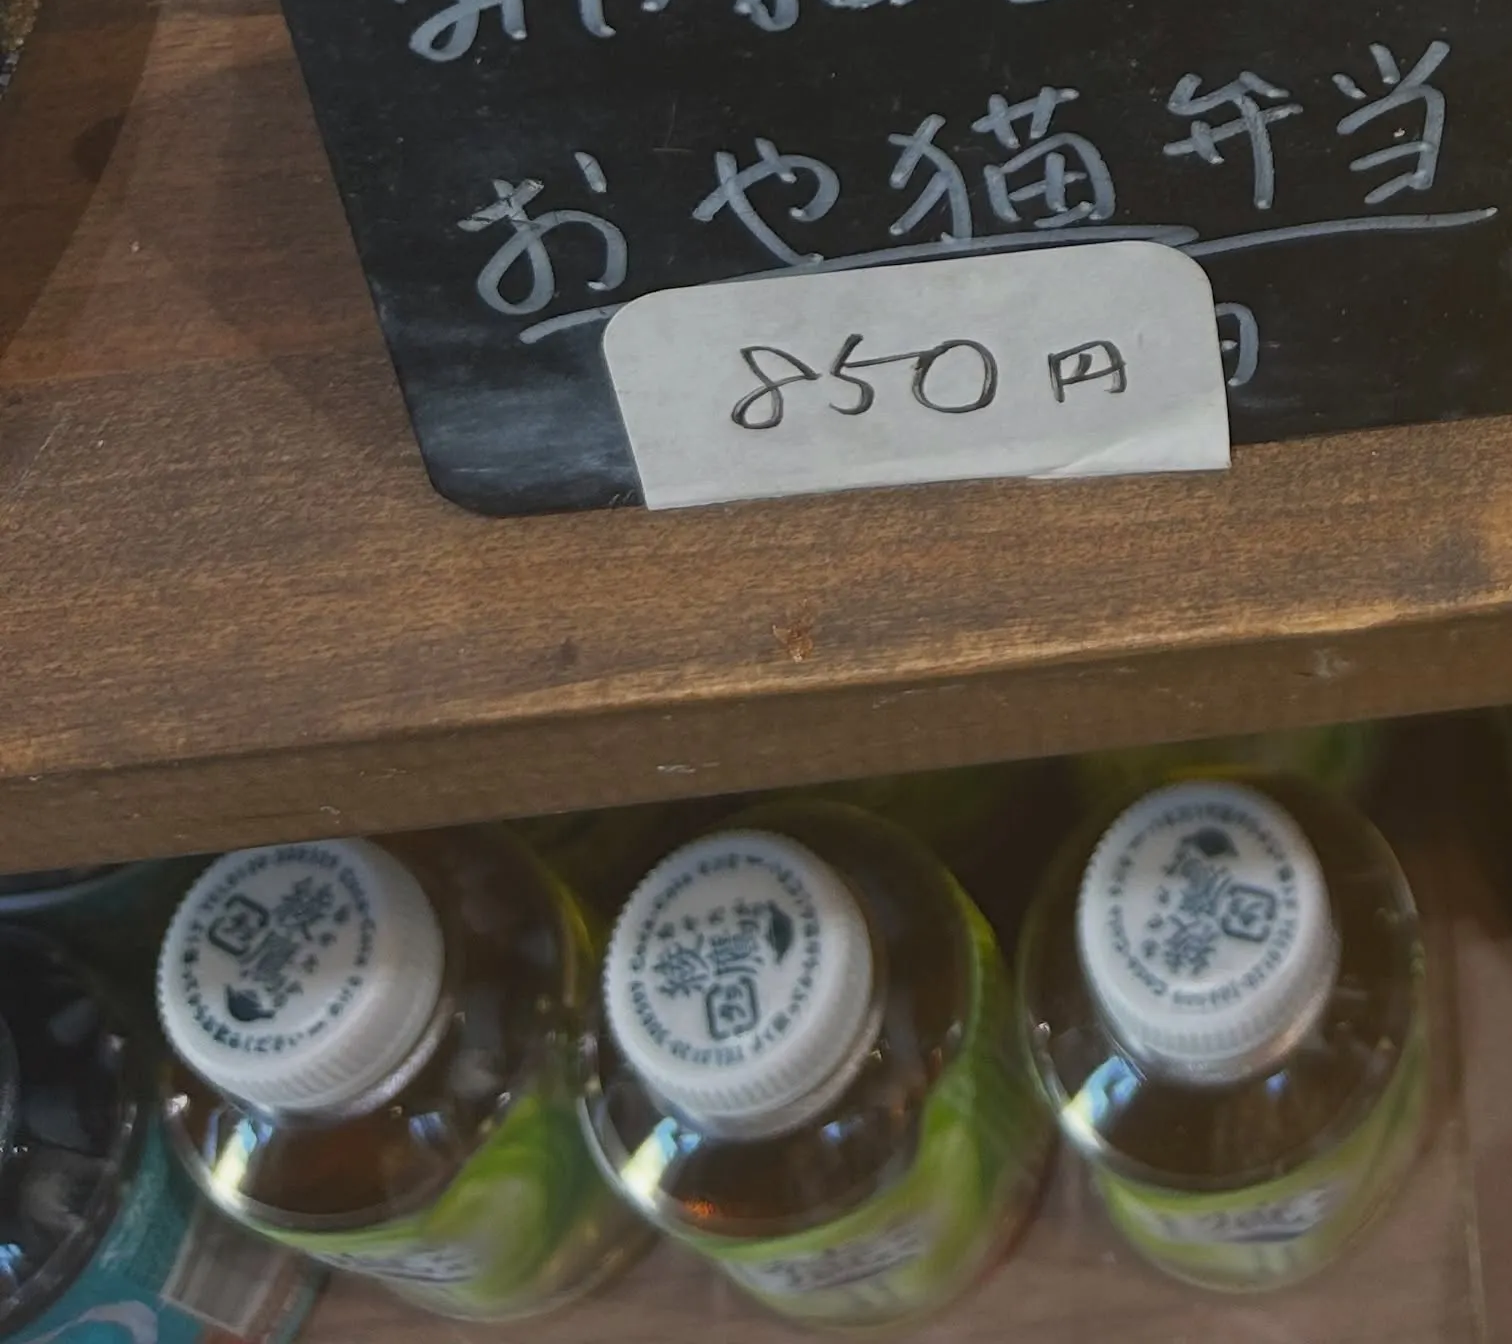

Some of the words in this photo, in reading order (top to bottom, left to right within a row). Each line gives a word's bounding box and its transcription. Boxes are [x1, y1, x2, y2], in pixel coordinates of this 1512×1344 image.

[457, 40, 1450, 315] おや猫弁当
[730, 333, 1130, 432] 850円
